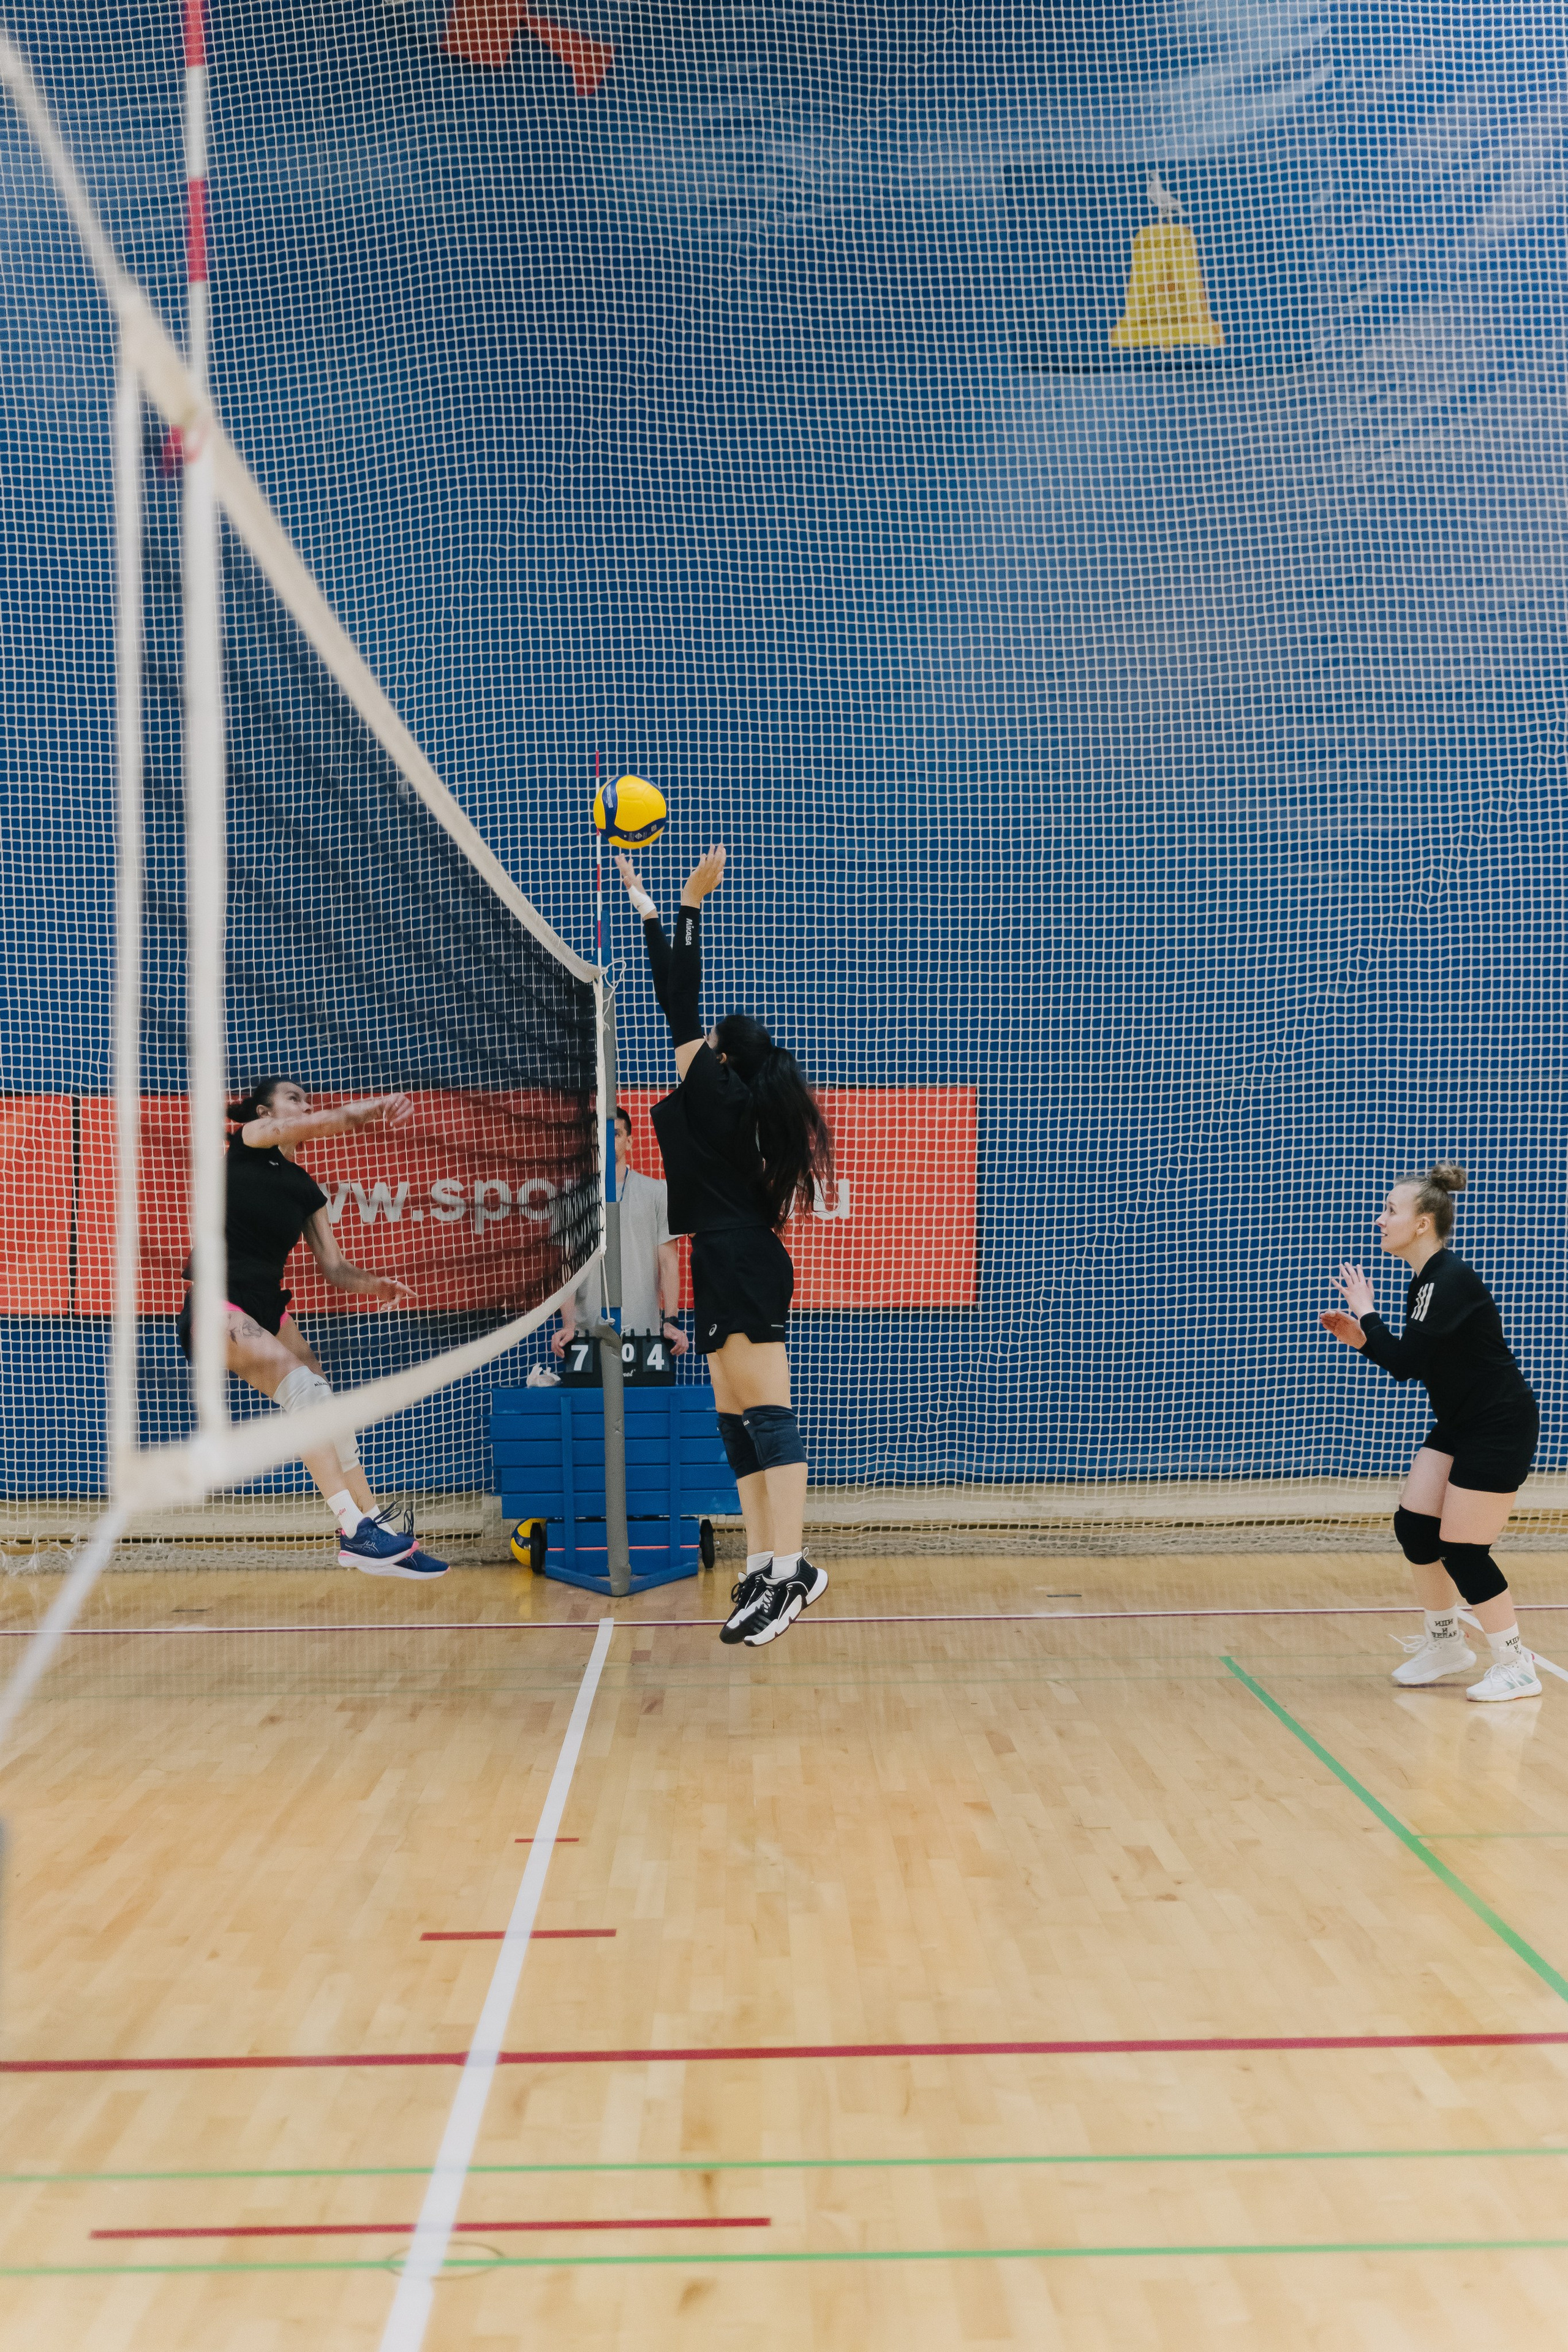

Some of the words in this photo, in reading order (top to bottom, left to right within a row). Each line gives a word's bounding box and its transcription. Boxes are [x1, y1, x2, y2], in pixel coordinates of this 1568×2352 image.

[571, 1344, 589, 1371] 7
[621, 1343, 635, 1363] 0
[647, 1343, 665, 1370] 4
